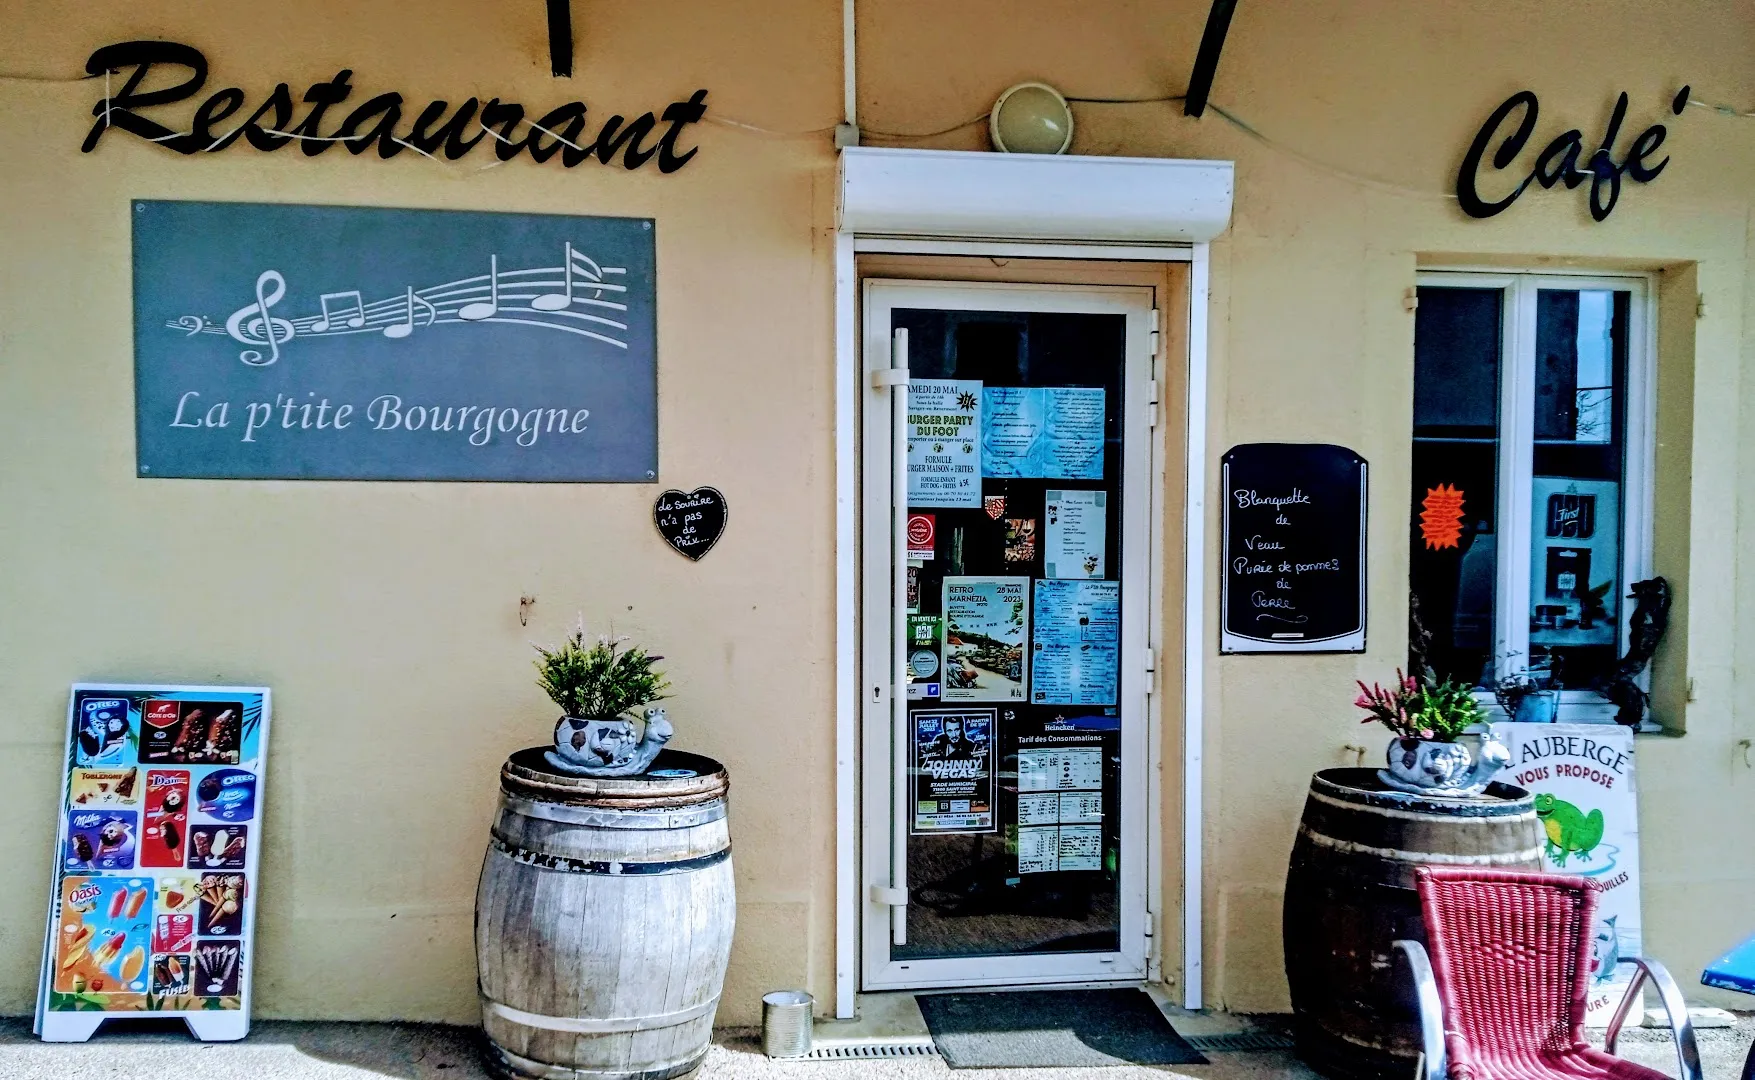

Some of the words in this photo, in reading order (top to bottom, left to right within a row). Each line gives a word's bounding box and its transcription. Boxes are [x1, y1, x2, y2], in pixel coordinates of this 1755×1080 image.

[81, 40, 709, 173] Restaurant
[1457, 85, 1691, 222] Café
[908, 385, 932, 394] AMEDI
[933, 386, 940, 394] 20
[942, 386, 958, 394] MAI
[169, 391, 231, 431] La
[240, 391, 354, 443] p'tite
[367, 394, 590, 448] Bourgogne
[943, 415, 974, 426] PARTY
[917, 427, 931, 436] DU
[933, 427, 959, 437] FOOT
[925, 456, 952, 464] FORMULE
[907, 465, 926, 473] URGER
[926, 465, 949, 473] MAISON
[954, 465, 974, 473] FRITES
[658, 497, 673, 512] Le
[1234, 487, 1311, 511] Blanquette
[661, 514, 677, 526] n'a
[684, 511, 702, 526] pas
[1557, 506, 1580, 521] First
[1275, 514, 1292, 526] de
[683, 526, 697, 535] de
[1245, 534, 1286, 550] Veau
[1278, 560, 1293, 573] de
[1276, 577, 1292, 589] de
[949, 586, 974, 594] RETRO
[996, 586, 1006, 594] 28
[949, 594, 988, 603] MARNÉZIA
[1003, 595, 1021, 603] 2023
[85, 700, 120, 711] OREO
[1034, 735, 1047, 743] des
[1048, 734, 1102, 742] Consommations
[1505, 736, 1630, 775] AUBERGE
[926, 759, 981, 771] JOHNNY
[222, 774, 255, 786] OREO
[932, 768, 977, 780] VEGAS
[1515, 766, 1550, 786] VOUS
[1555, 764, 1615, 789] PROPOSE
[73, 812, 101, 826] Milka
[1599, 871, 1630, 893] OUILLES
[69, 884, 102, 903] Oasis
